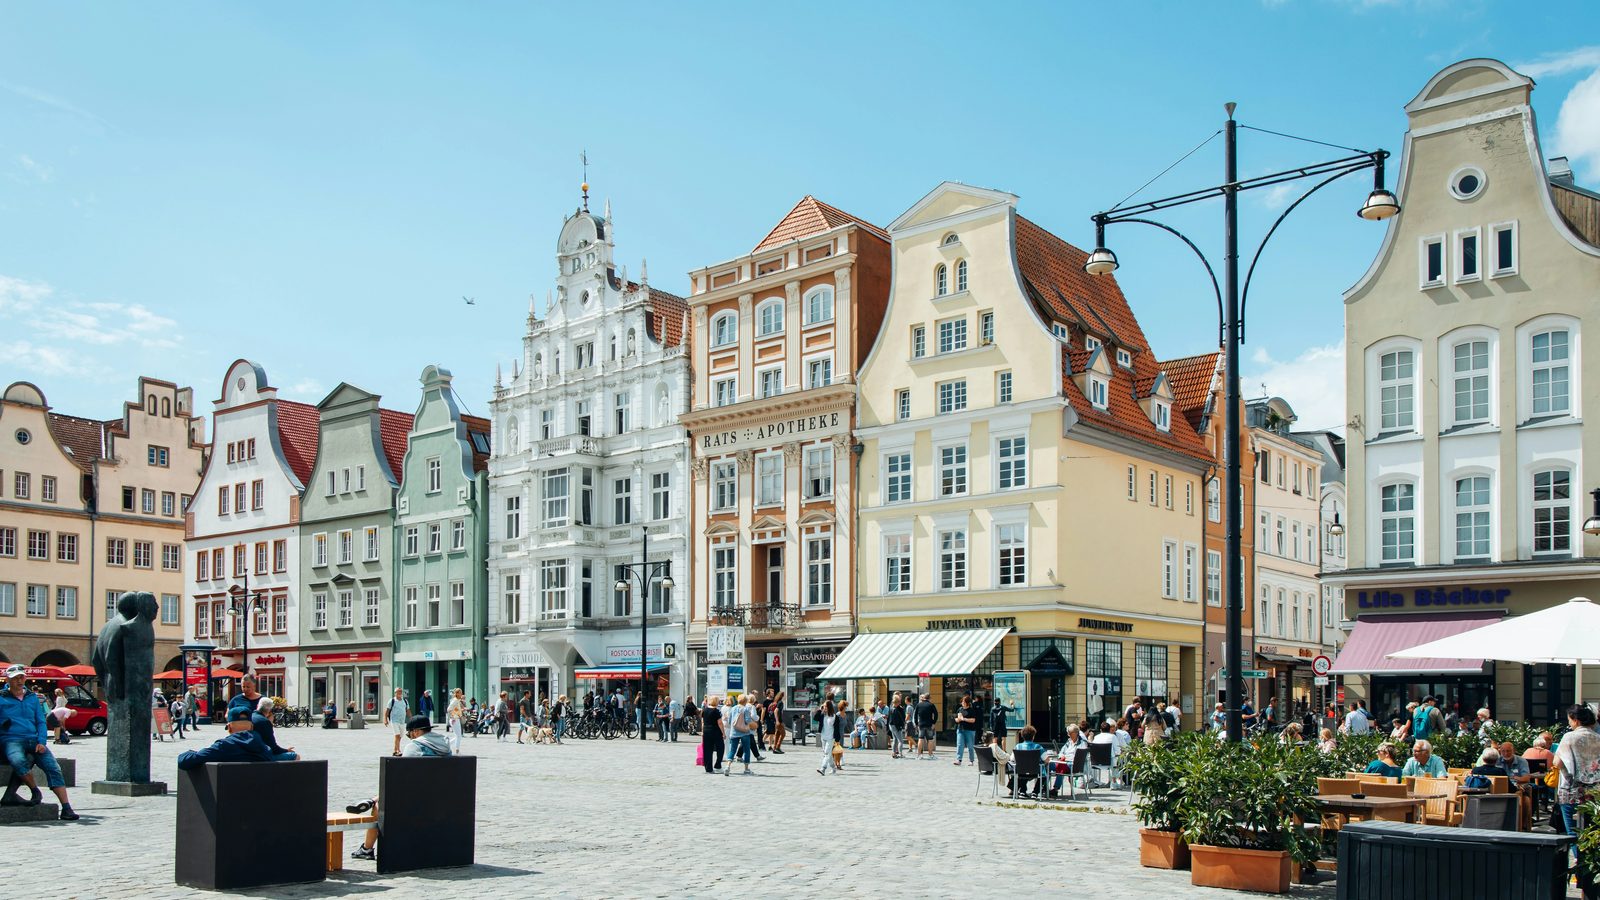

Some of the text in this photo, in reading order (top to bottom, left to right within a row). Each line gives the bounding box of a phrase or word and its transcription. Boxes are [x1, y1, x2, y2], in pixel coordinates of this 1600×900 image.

[703, 412, 839, 448] RATS APOTHEKE
[1358, 587, 1512, 608] Lila Bäcker
[983, 616, 1016, 627] WITT
[501, 653, 545, 664] FESTMODE
[610, 649, 636, 657] ROSTOCK
